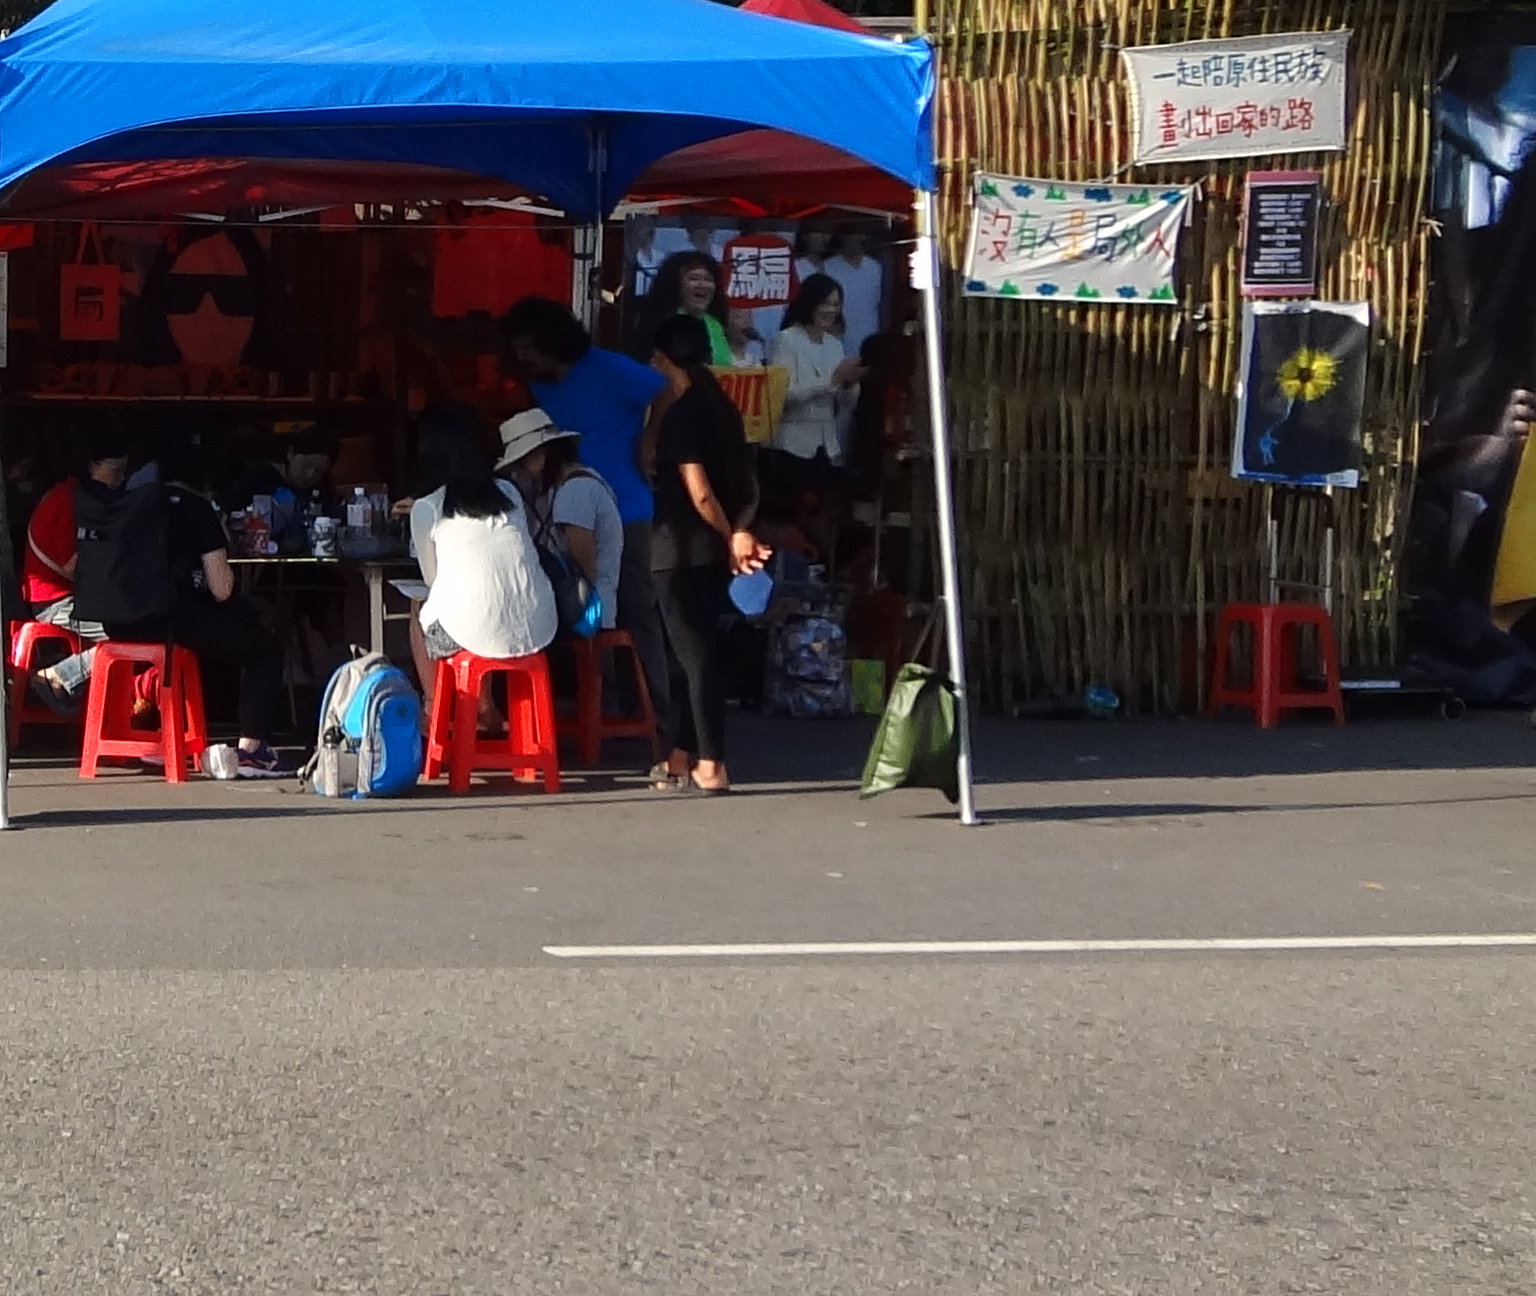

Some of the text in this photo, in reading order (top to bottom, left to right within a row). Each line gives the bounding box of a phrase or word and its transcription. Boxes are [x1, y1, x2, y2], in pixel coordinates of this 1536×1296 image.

[1153, 49, 1326, 88] 一起陪原住民族
[1158, 97, 1315, 148] 劃出回家的路
